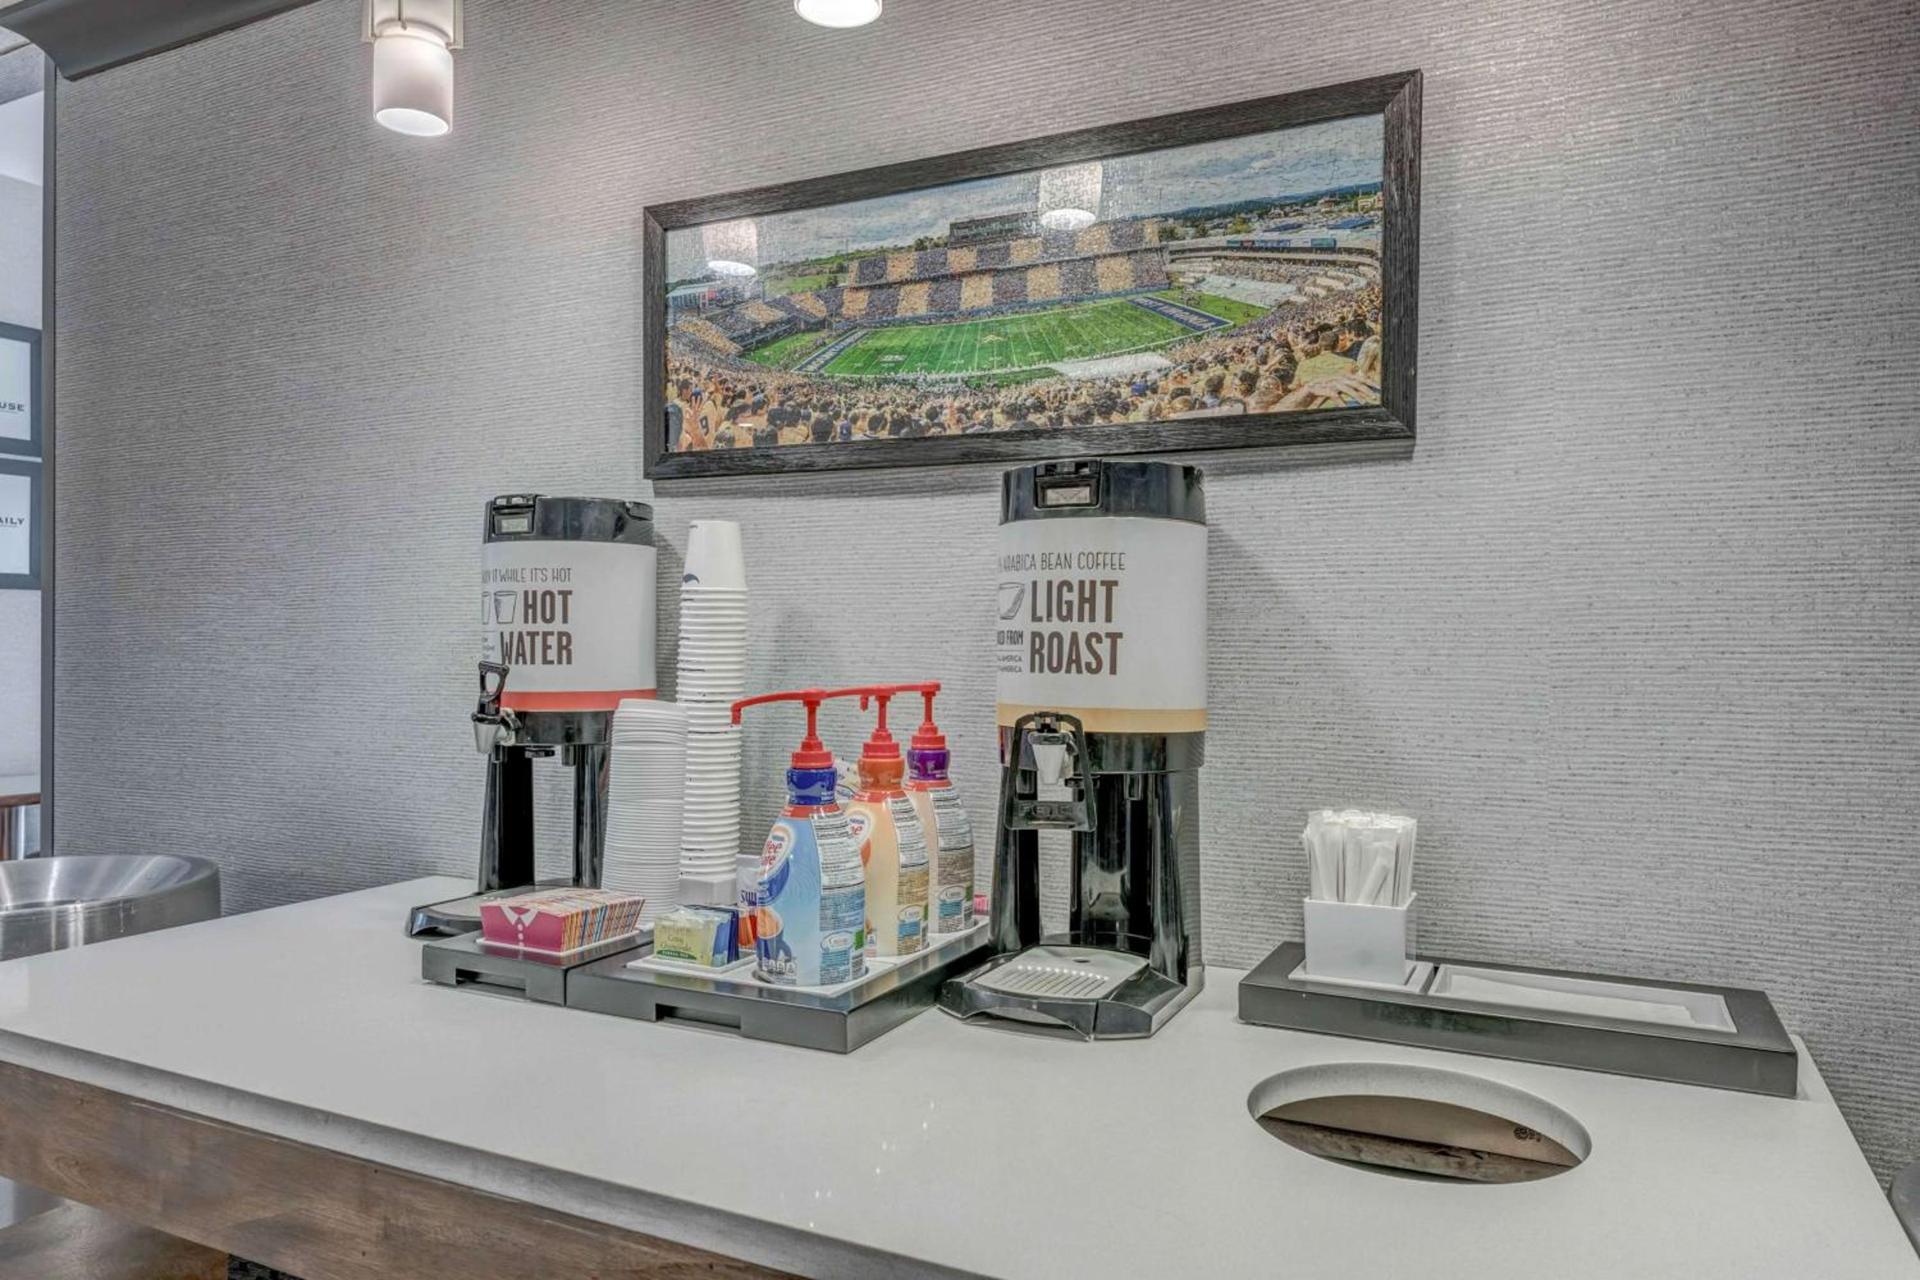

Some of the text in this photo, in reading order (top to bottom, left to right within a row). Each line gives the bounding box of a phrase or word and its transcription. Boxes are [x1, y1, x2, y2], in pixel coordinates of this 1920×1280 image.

[500, 567, 527, 583] WHILE
[530, 567, 548, 582] IT'S
[552, 567, 572, 583] HOT
[1041, 552, 1073, 570] BEAN
[1077, 551, 1126, 571] COFFEE
[523, 589, 573, 625] HOT
[1031, 579, 1119, 623] LIGHT
[500, 630, 573, 665] WATER
[1029, 630, 1124, 676] ROAST
